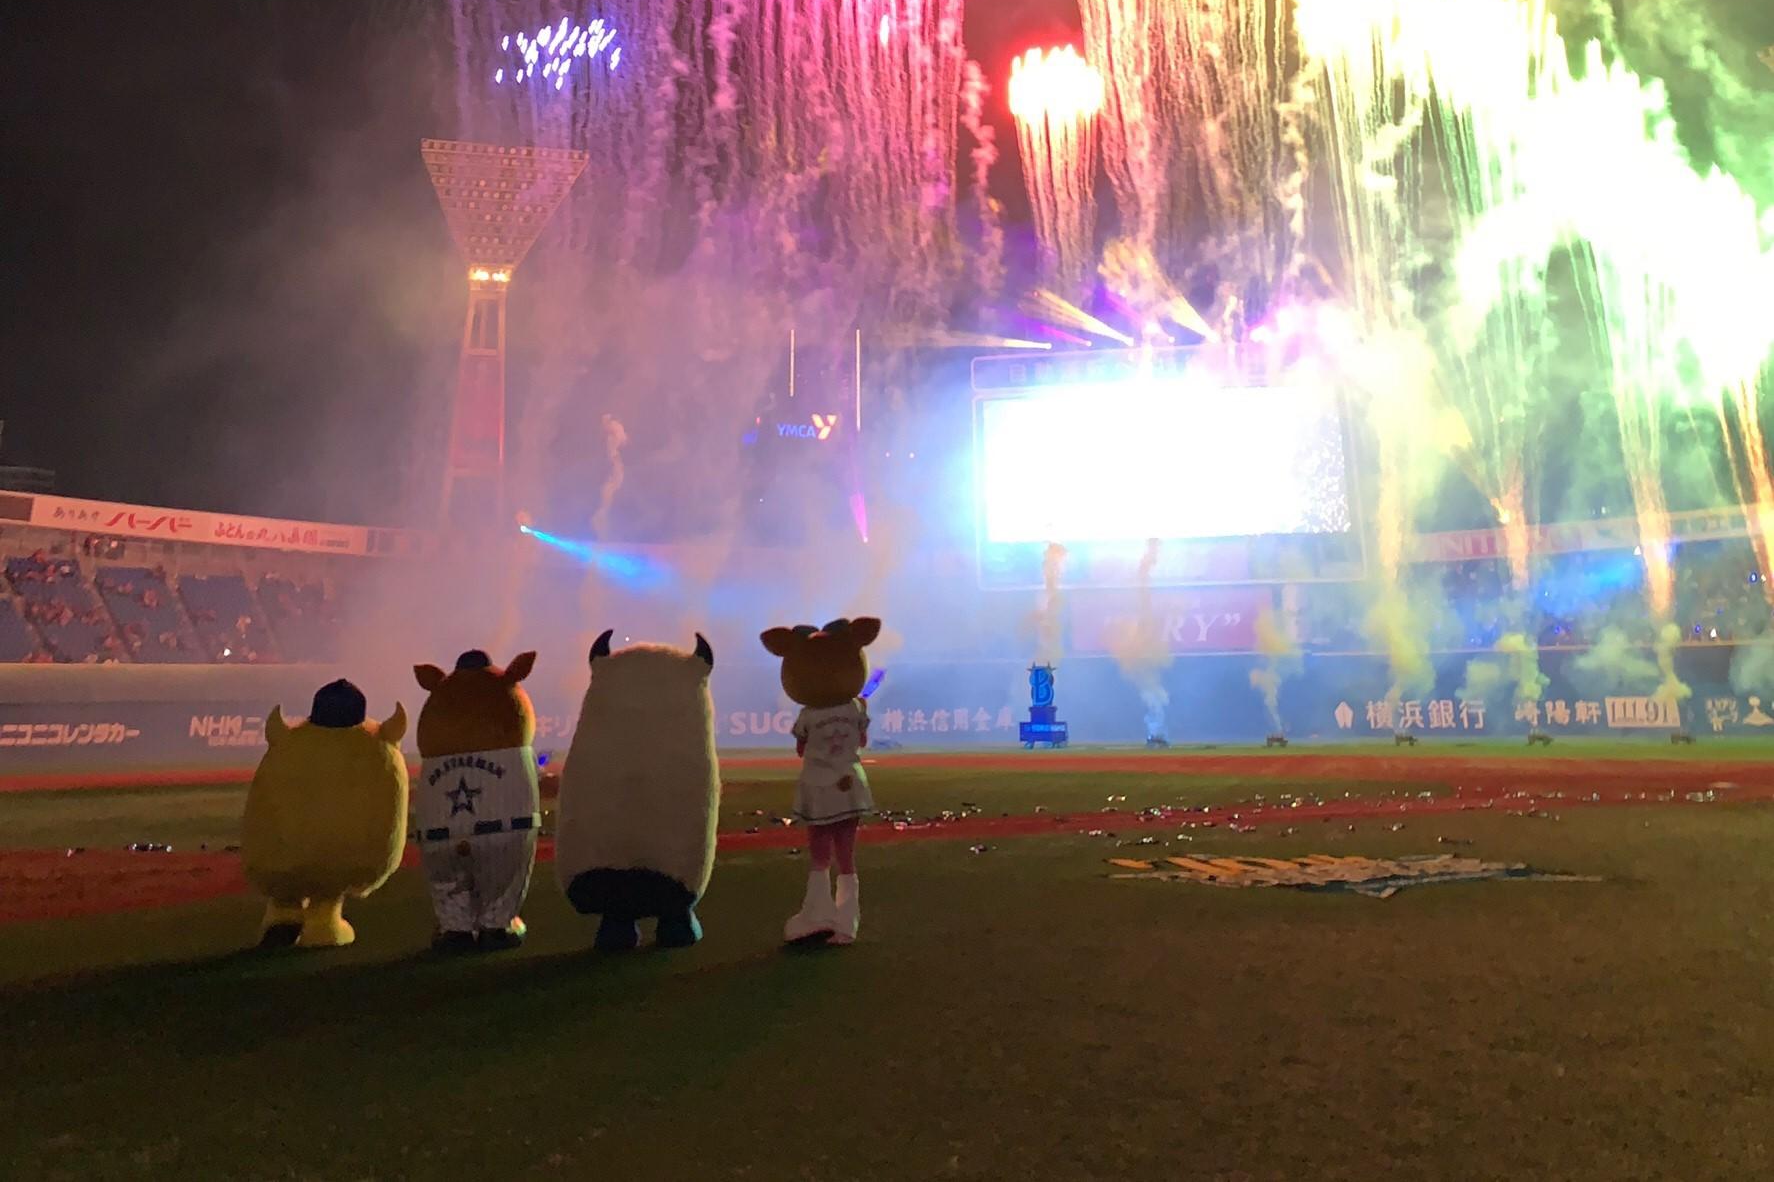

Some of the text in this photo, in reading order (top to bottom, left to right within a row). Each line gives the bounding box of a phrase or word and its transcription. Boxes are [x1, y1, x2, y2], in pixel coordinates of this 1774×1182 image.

[777, 424, 816, 438] YMCA
[881, 706, 1015, 733] 横浜信用金庫
[1366, 699, 1486, 730] 横浜銀行
[1514, 699, 1602, 727] 崎陽軒
[0, 723, 140, 746] ニコニコレンタカー
